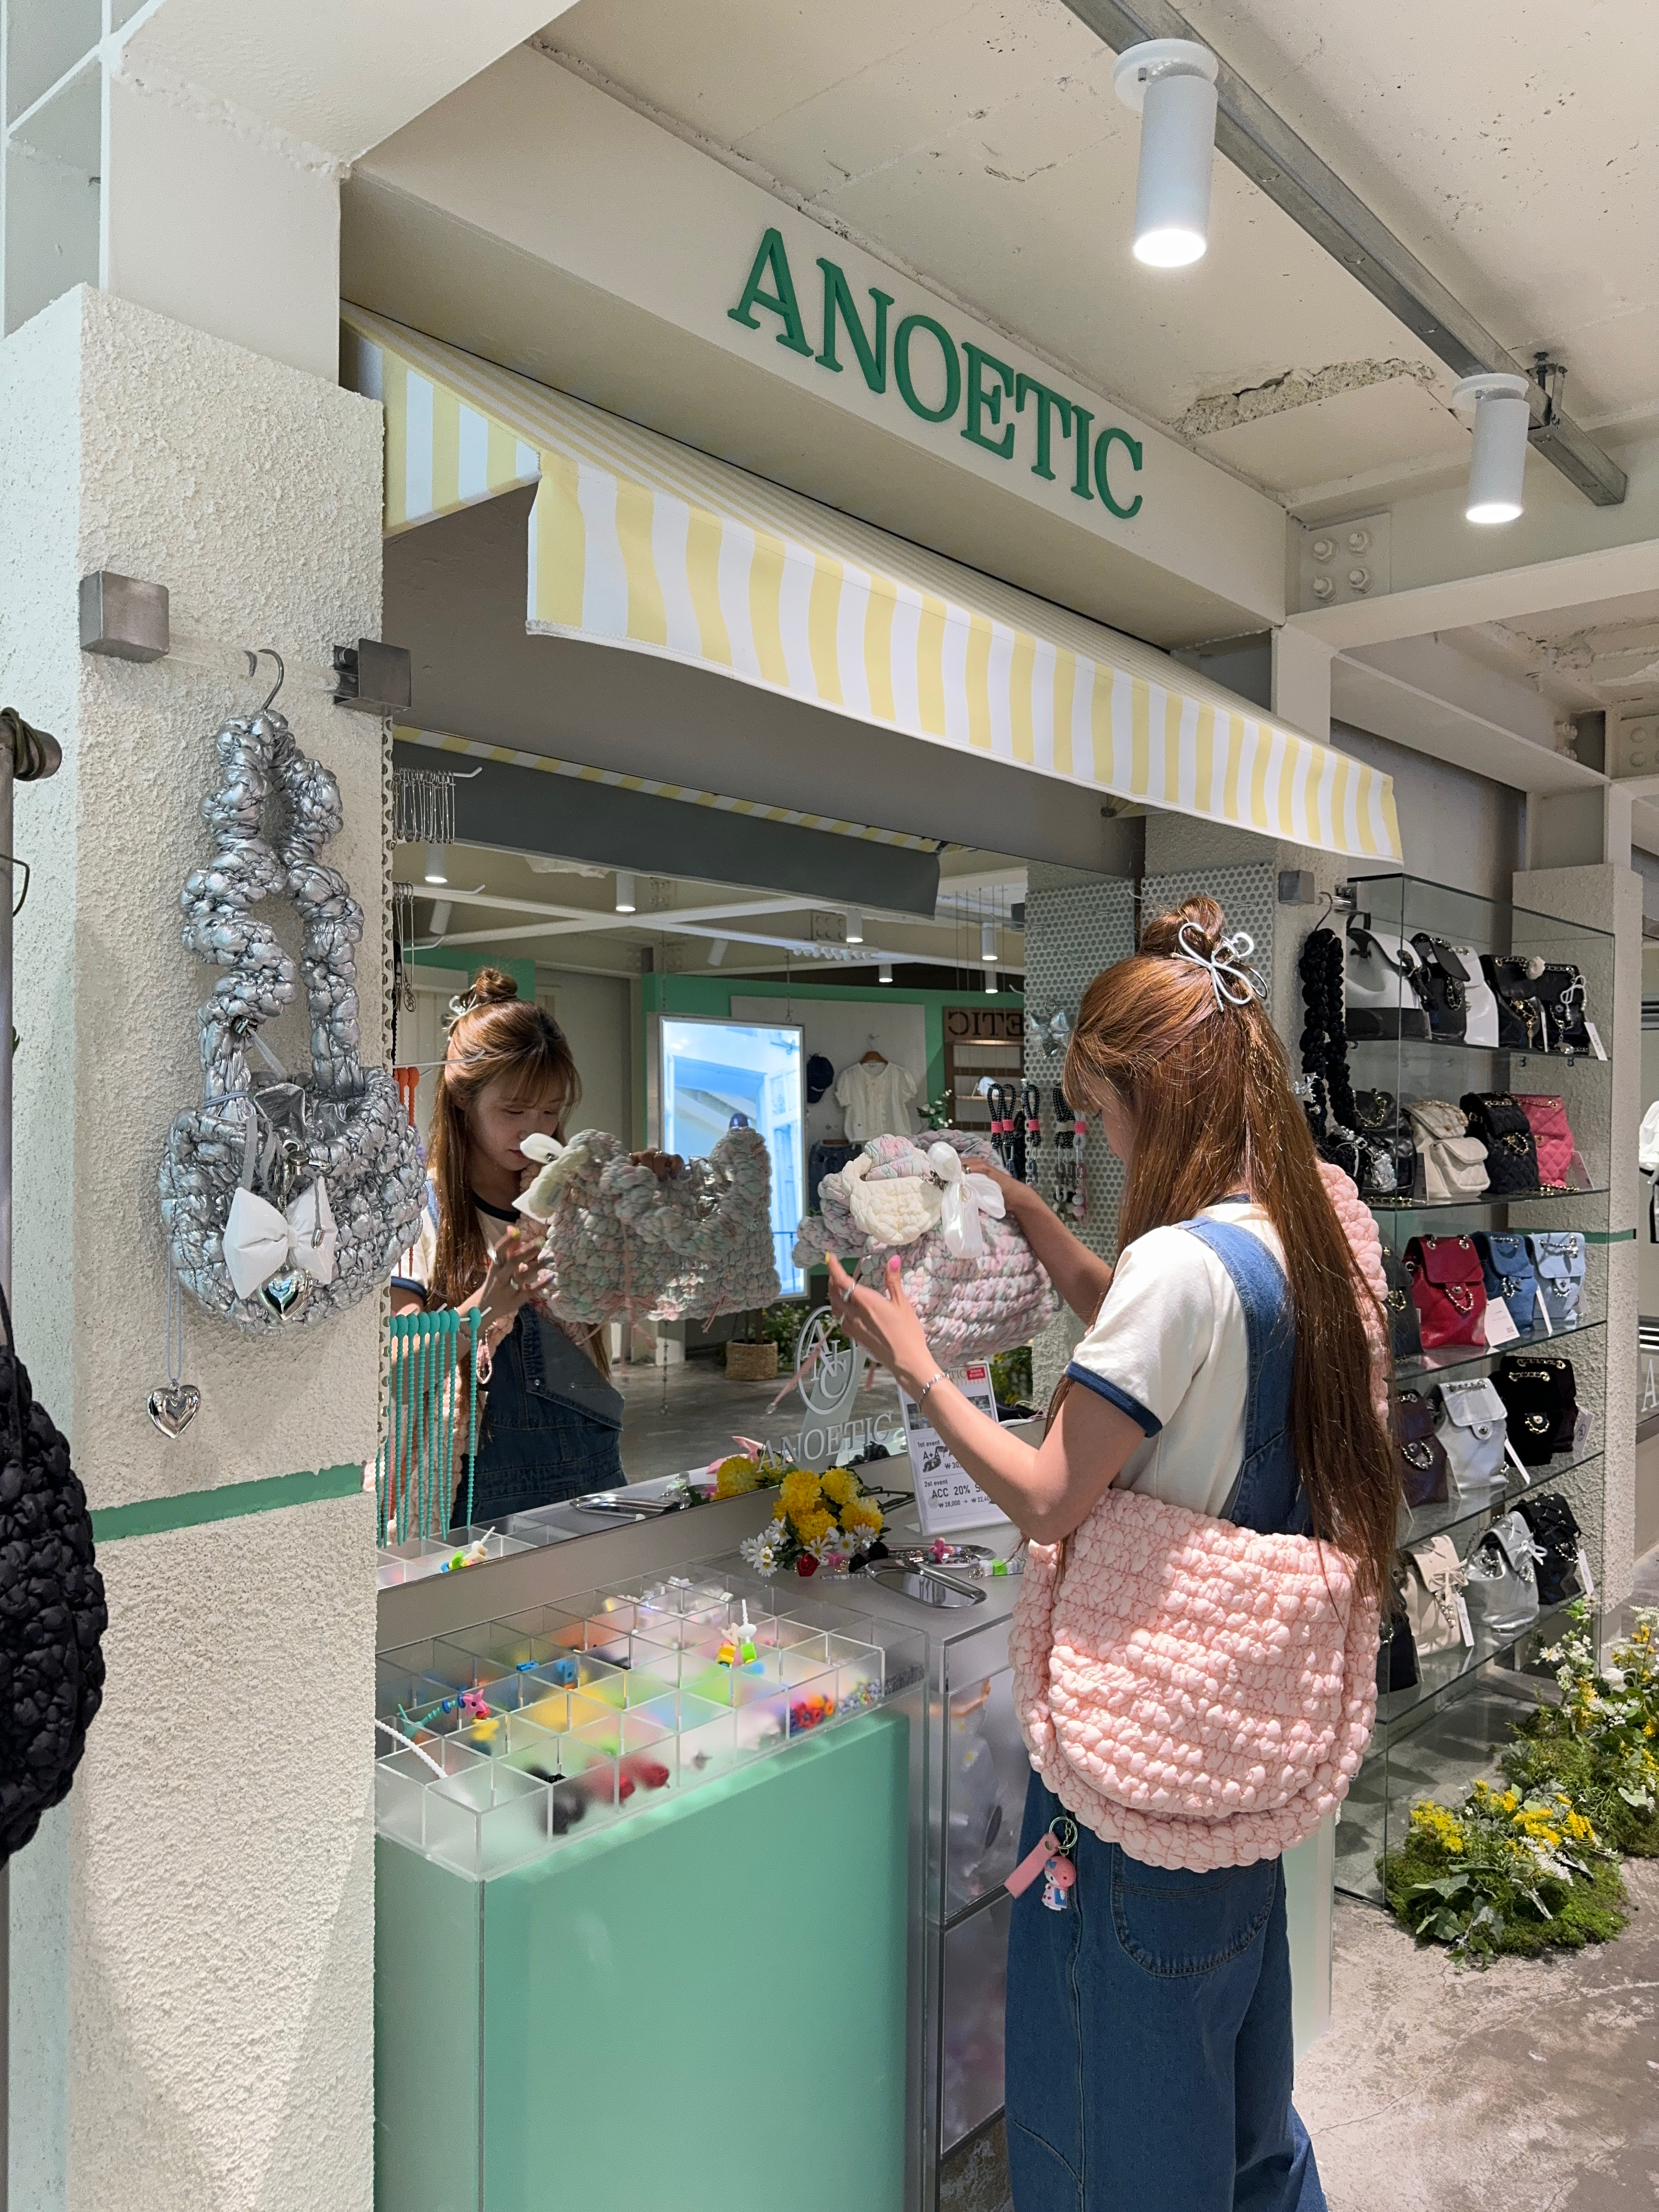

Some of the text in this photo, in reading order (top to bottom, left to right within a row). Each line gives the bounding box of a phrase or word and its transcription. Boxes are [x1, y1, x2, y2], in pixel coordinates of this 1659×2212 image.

[727, 228, 1143, 519] ANOETIC
[756, 1413, 891, 1473] ANOETIC
[932, 1487, 949, 1499] ACC
[953, 1485, 970, 1496] 20%
